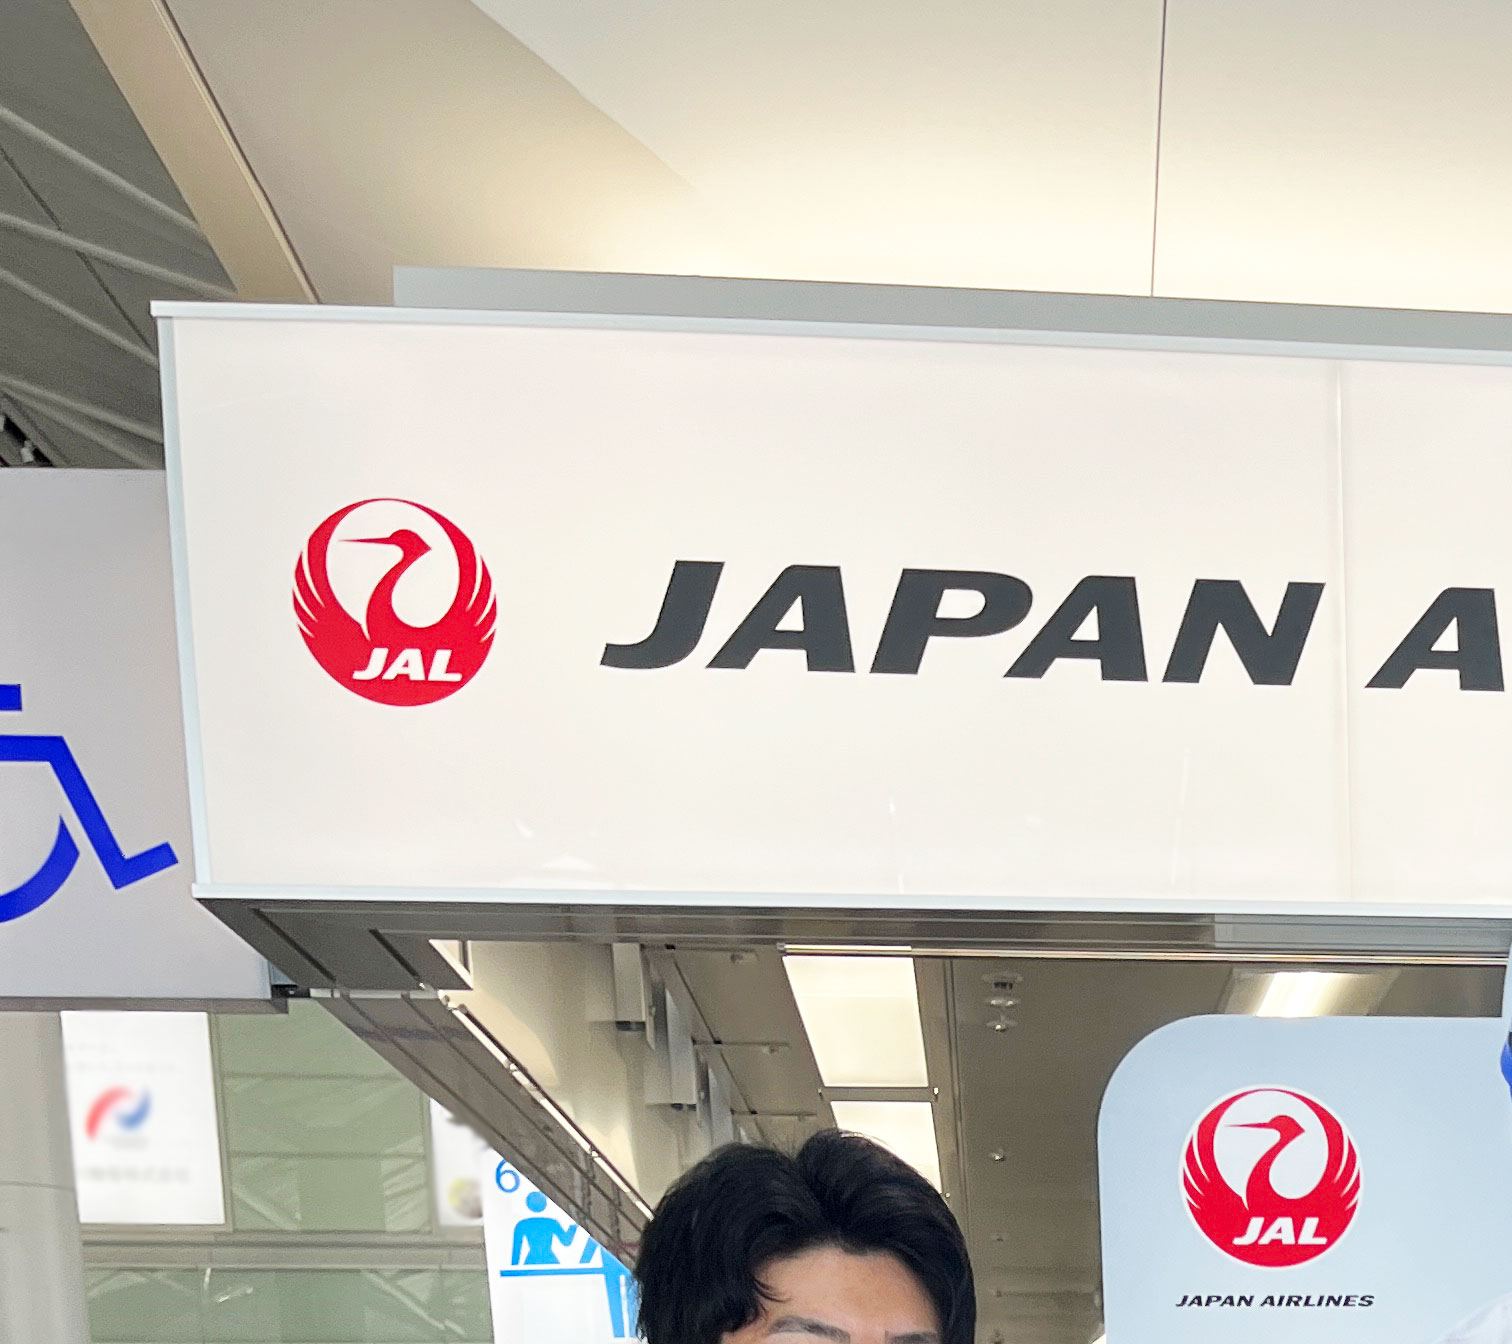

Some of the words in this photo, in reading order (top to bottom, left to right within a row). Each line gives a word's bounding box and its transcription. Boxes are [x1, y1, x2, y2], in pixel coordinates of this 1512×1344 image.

[600, 559, 1326, 686] JAPAN
[352, 647, 463, 682] JAL
[1232, 1216, 1328, 1245] JAL
[1175, 1295, 1254, 1307] JAPAN
[1260, 1295, 1375, 1307] AIRLINES
